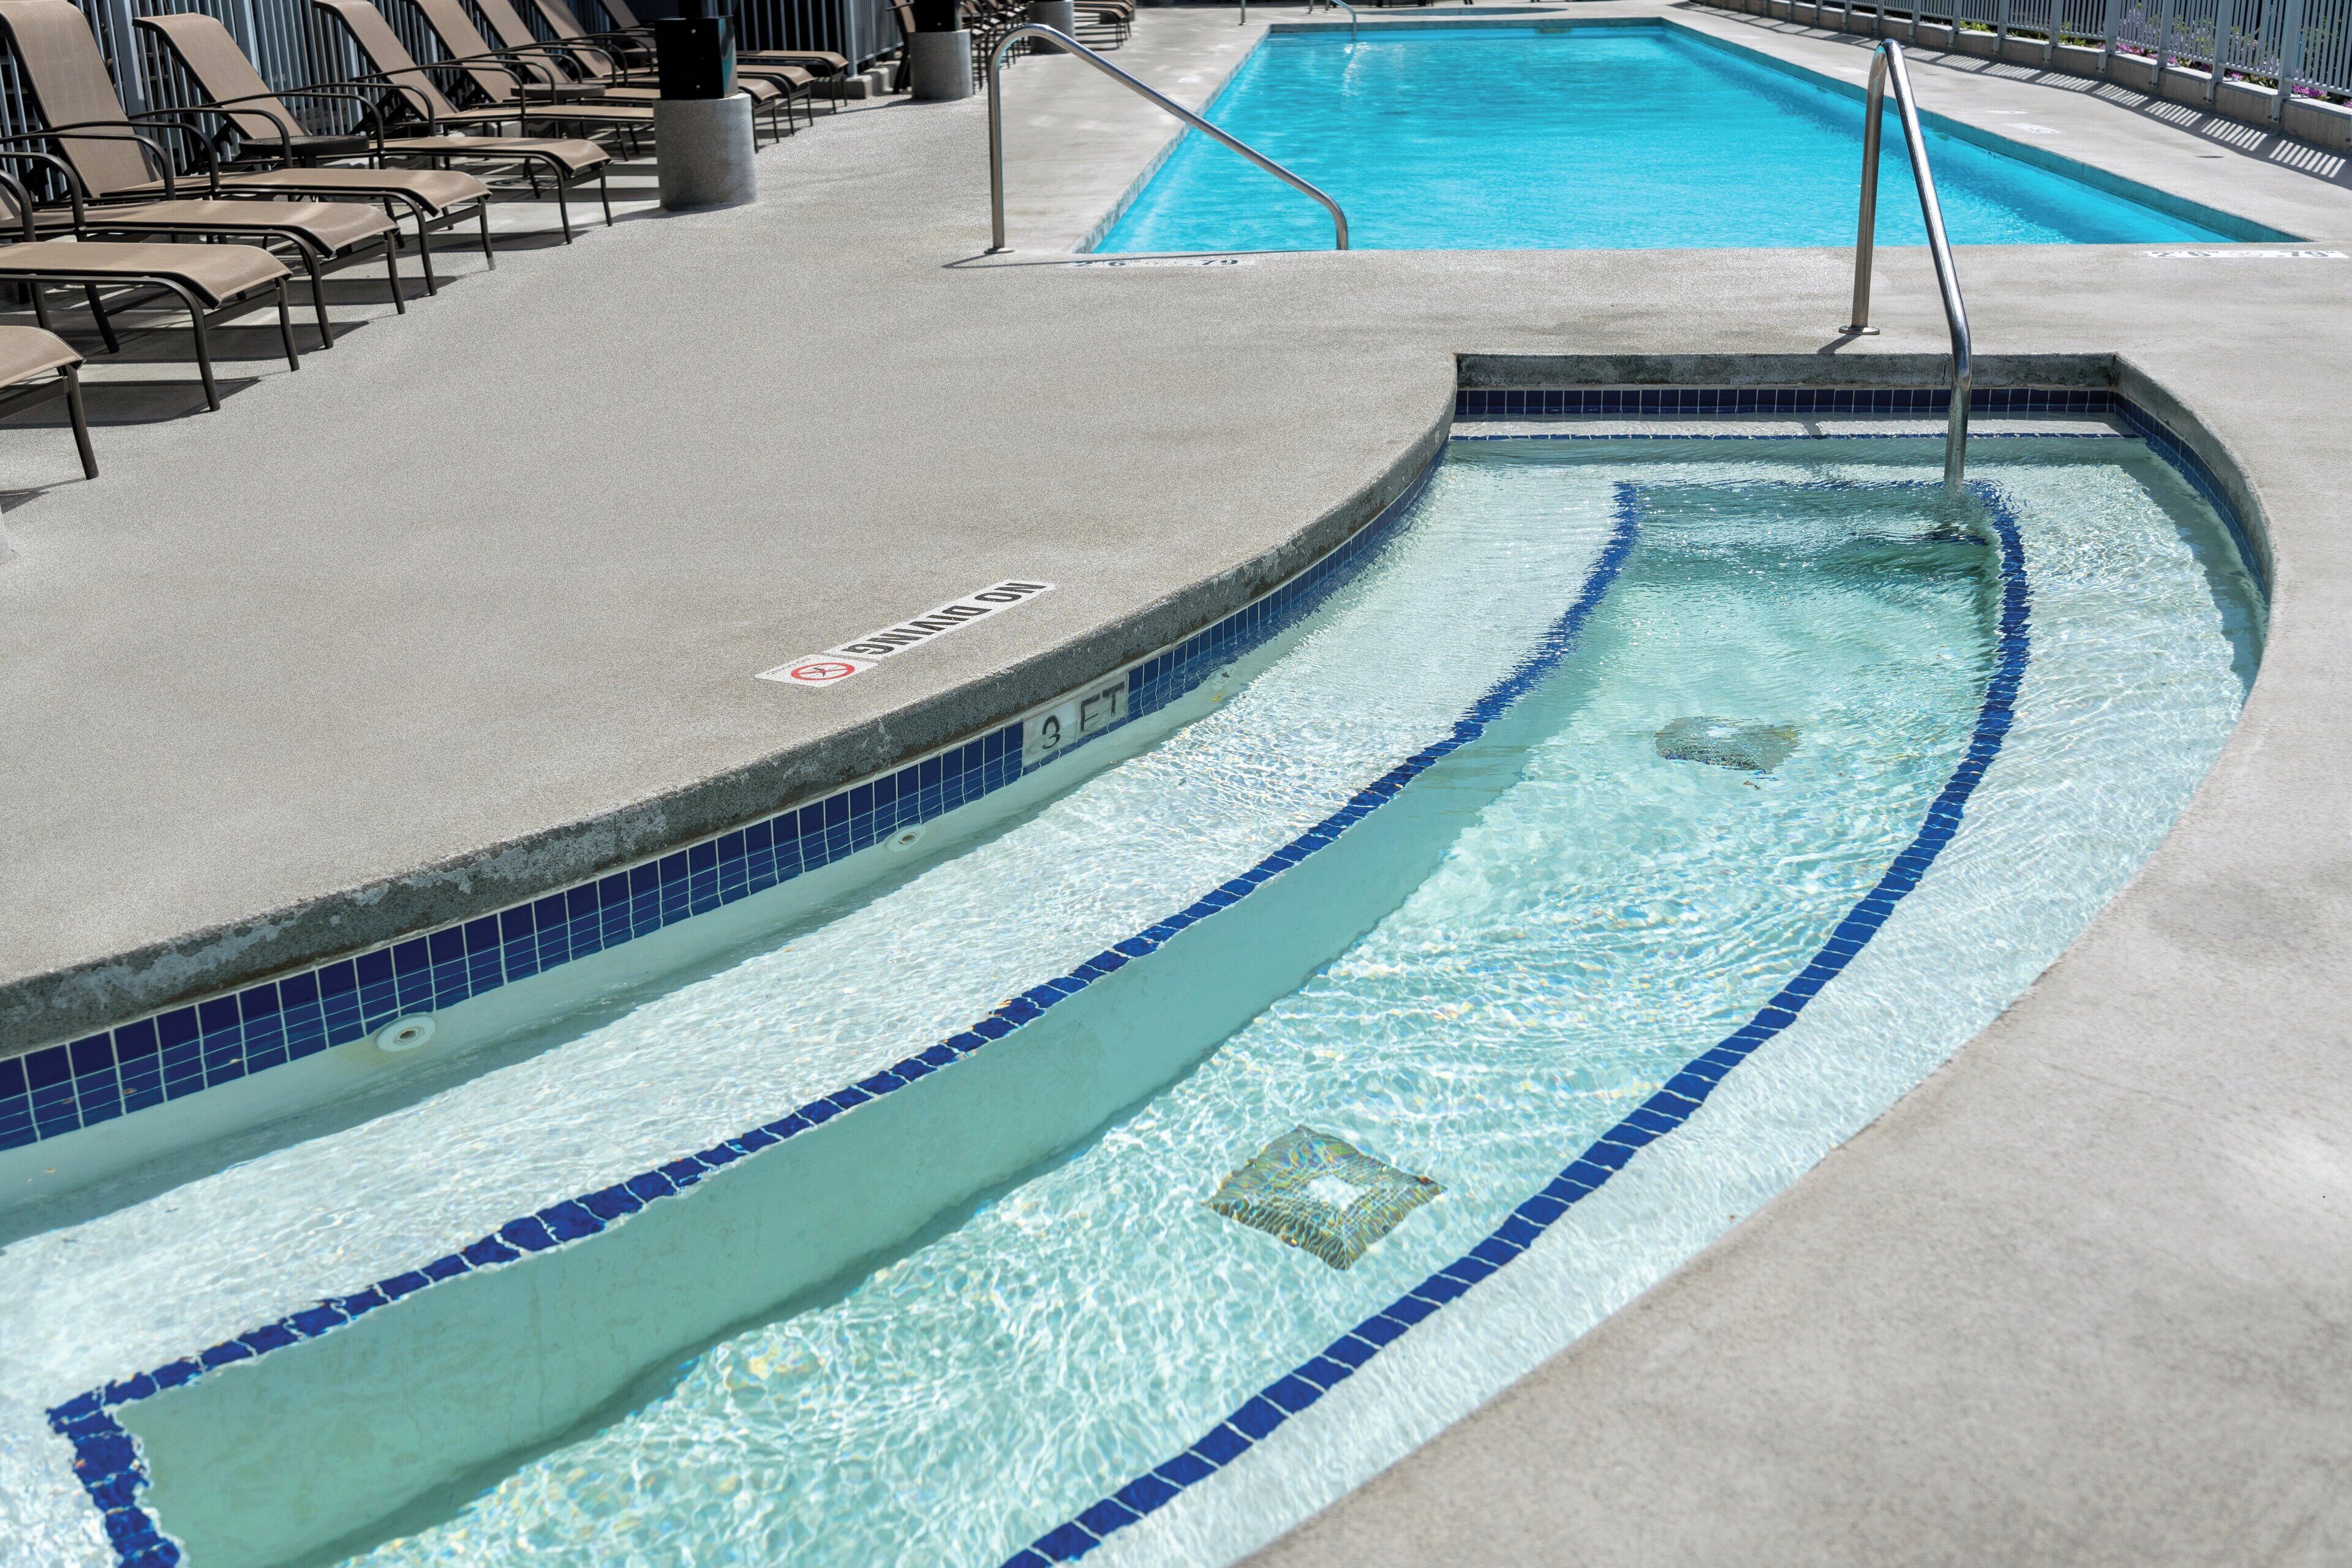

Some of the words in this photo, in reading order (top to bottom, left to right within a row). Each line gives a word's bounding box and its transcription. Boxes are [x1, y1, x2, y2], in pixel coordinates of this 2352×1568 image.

[974, 582, 1047, 603] NO
[841, 605, 993, 655] DIVING
[1042, 715, 1061, 750] 3
[1080, 680, 1125, 733] FT
